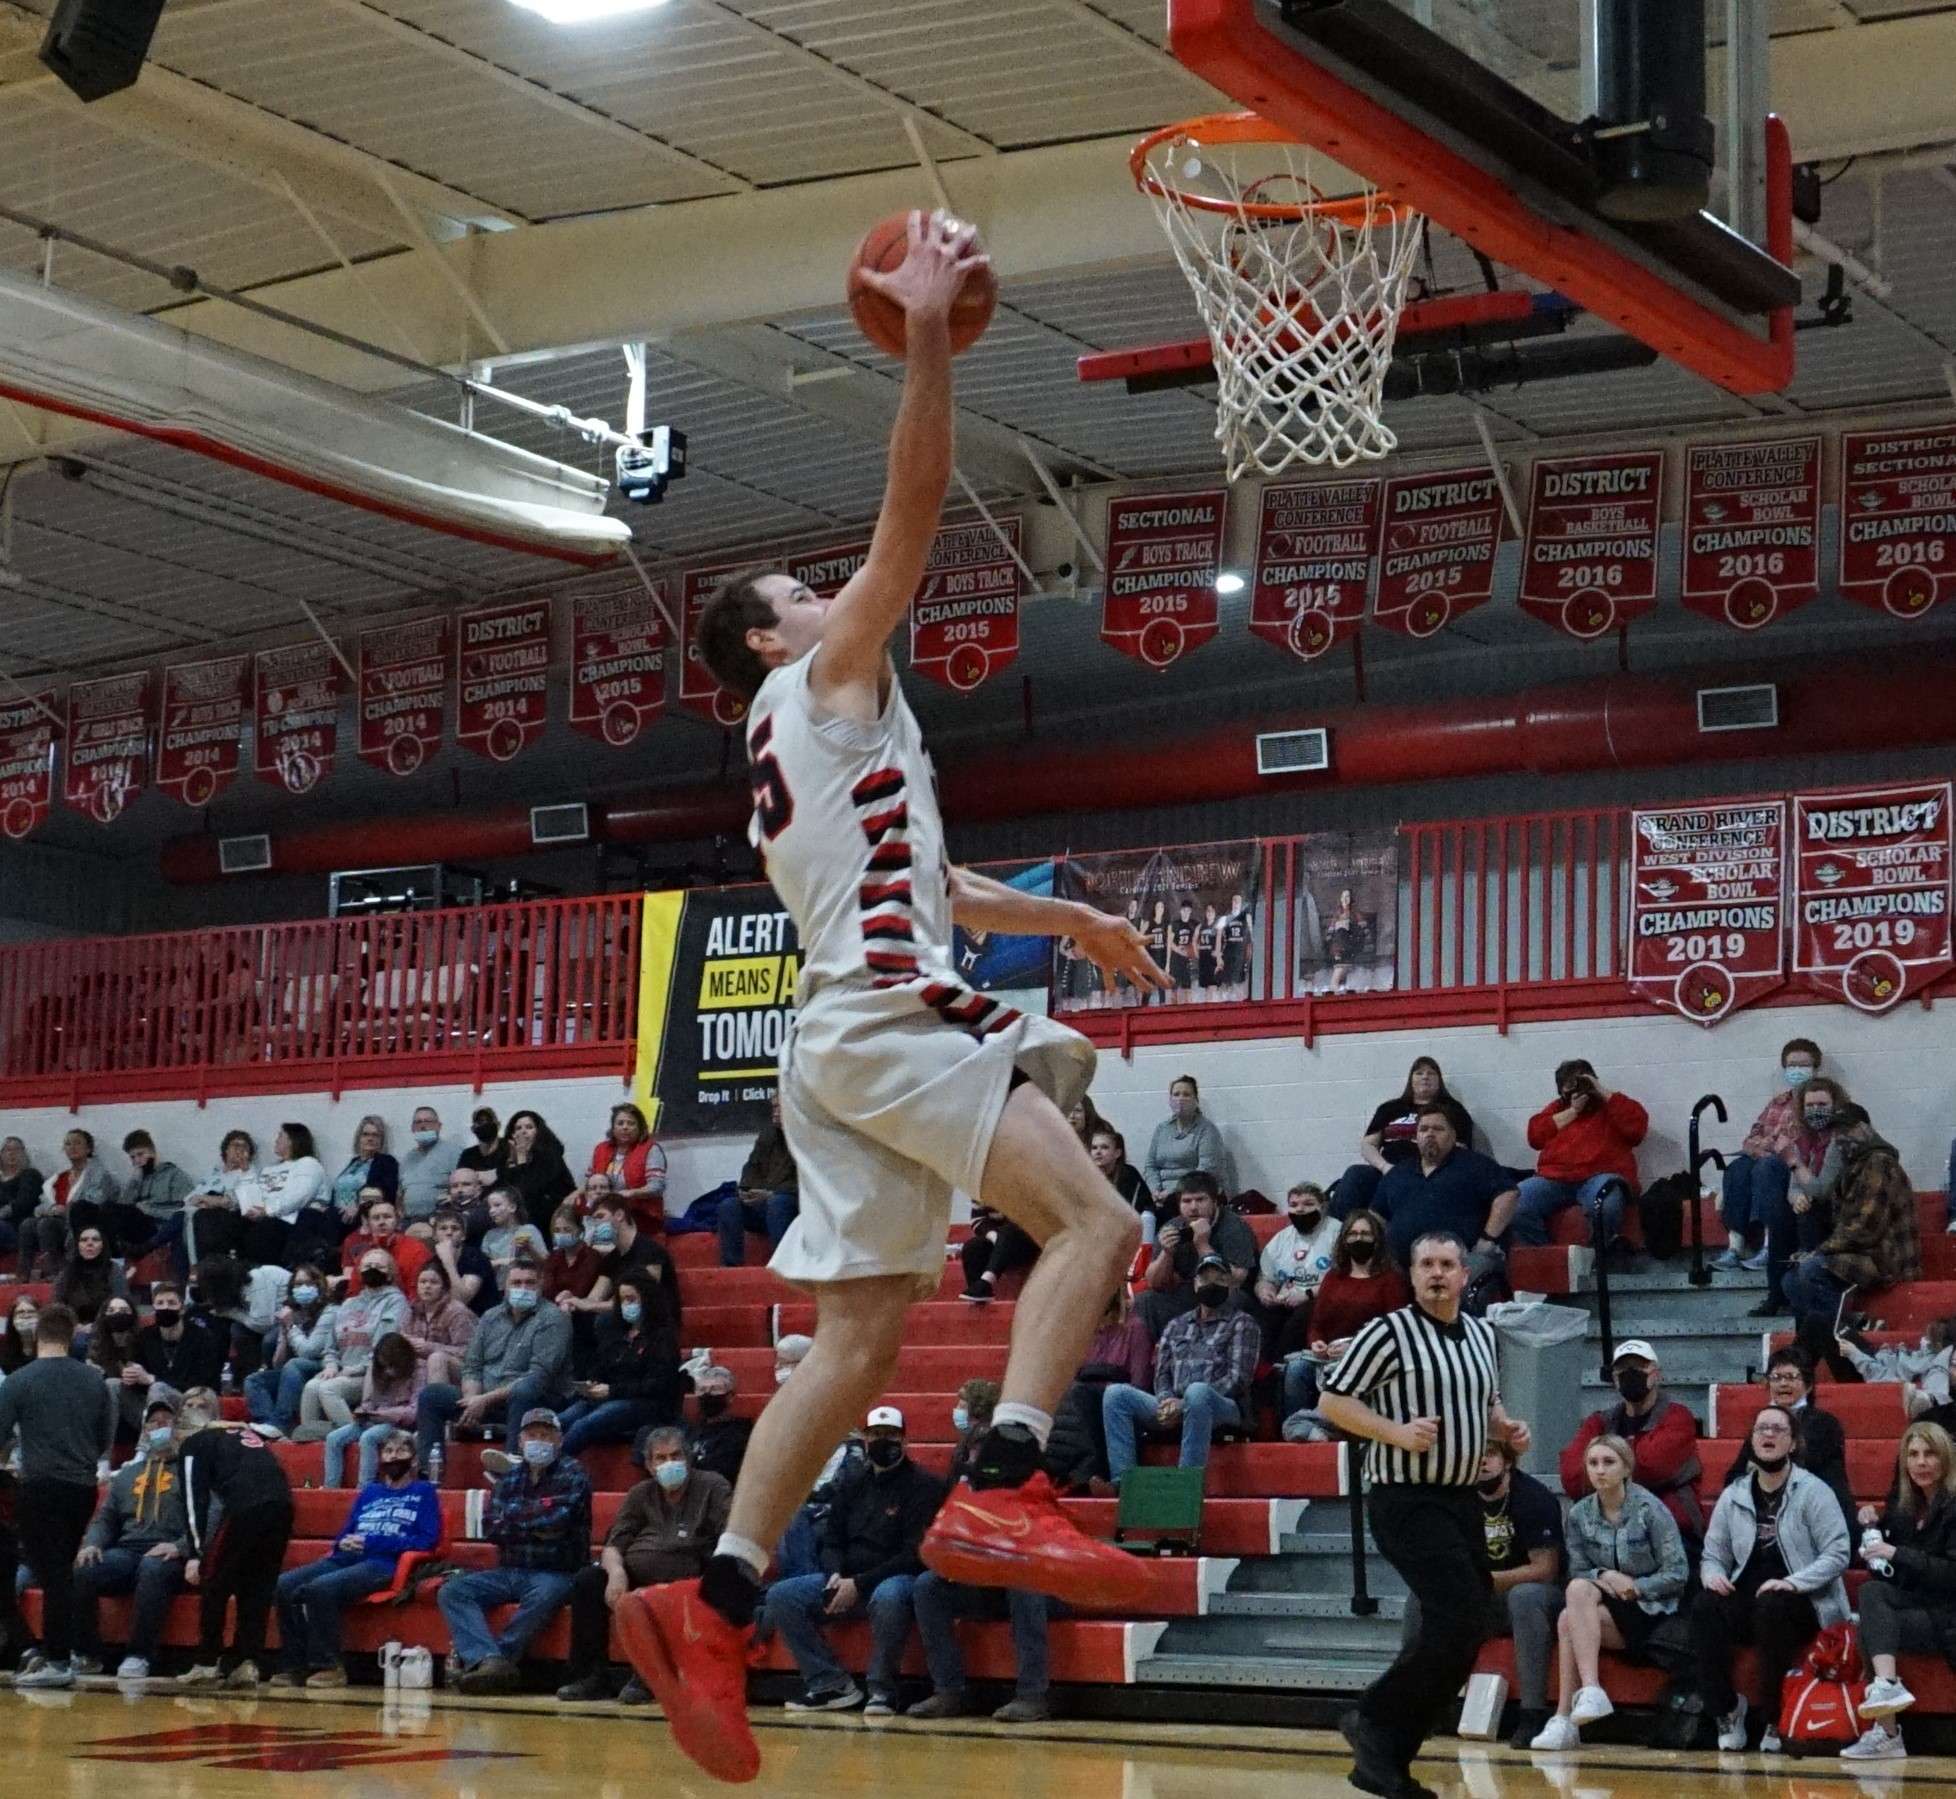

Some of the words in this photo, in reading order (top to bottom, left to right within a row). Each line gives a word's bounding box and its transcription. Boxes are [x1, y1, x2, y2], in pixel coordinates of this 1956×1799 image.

[1693, 450, 1755, 471] PLATTE
[1854, 454, 1956, 475] SECTIONA
[1544, 467, 1651, 496] DISTRICT
[1704, 465, 1804, 488] CONFERENCE
[1899, 477, 1956, 494] SCHOLA
[1267, 489, 1320, 508] PLATTE
[1322, 485, 1374, 505] VALLEY
[1395, 479, 1497, 513] DISTRICT
[1740, 490, 1808, 508] SCHOLAR
[1910, 492, 1955, 508] BOWL
[1118, 507, 1215, 530] SECTIONAL
[1275, 506, 1364, 527] CONFERENCE
[1592, 507, 1625, 520] BOYS
[1752, 506, 1794, 521] BOWL
[1420, 516, 1492, 543] FOOTBALL
[1567, 518, 1649, 534] BASKETBALL
[1849, 514, 1956, 542] CHAMPION
[1143, 544, 1171, 565] BOYS
[1176, 540, 1215, 561] TRACK
[1295, 533, 1366, 554] FOOTBALL
[1535, 538, 1651, 562] CHAMPIONS
[1693, 527, 1811, 554] CHAMPIONS
[1386, 543, 1491, 576] CHAMPIONS
[1719, 552, 1784, 577] 2016
[1876, 540, 1945, 566] 2016
[946, 572, 975, 593] BOYS
[977, 567, 1015, 589] TRACK
[1112, 568, 1215, 595] CHAMPIONS
[1262, 562, 1367, 586] CHAMPIONS
[1405, 566, 1462, 594] 2015
[1558, 564, 1622, 587] 2016
[1139, 594, 1188, 614] 2015
[1284, 583, 1341, 608] 2015
[918, 596, 1014, 625] CHAMPIONS
[468, 611, 544, 644] DISTRICT
[944, 621, 990, 642] 2015
[489, 645, 546, 672] FOOTBALL
[579, 654, 662, 684] CHAMPIONS
[464, 674, 545, 704] CHAMPIONS
[598, 677, 641, 700] 2015
[483, 697, 527, 720] 2014
[384, 713, 427, 736] 2014
[184, 746, 220, 766] 2014
[1714, 808, 1778, 829] RIVER
[1807, 801, 1938, 840] DISTRICT
[1652, 828, 1766, 852] CONFERENCE
[1644, 853, 1691, 866] WEST
[1696, 847, 1774, 863] DIVISION
[1855, 845, 1941, 867] SCHOLAR
[1692, 863, 1773, 882] SCHOLAR
[1872, 865, 1925, 884] BOWL
[1707, 882, 1756, 899] BOWL
[1805, 890, 1945, 924] CHAMPIONS
[1639, 907, 1774, 936] CHAMPIONS
[706, 912, 790, 956] ALERT
[1834, 919, 1915, 950] 2019
[1667, 934, 1745, 961] 2019
[709, 968, 771, 998] MEANS
[697, 1009, 797, 1061] TOMO
[697, 1091, 720, 1105] Drop
[742, 1088, 765, 1101] Click
